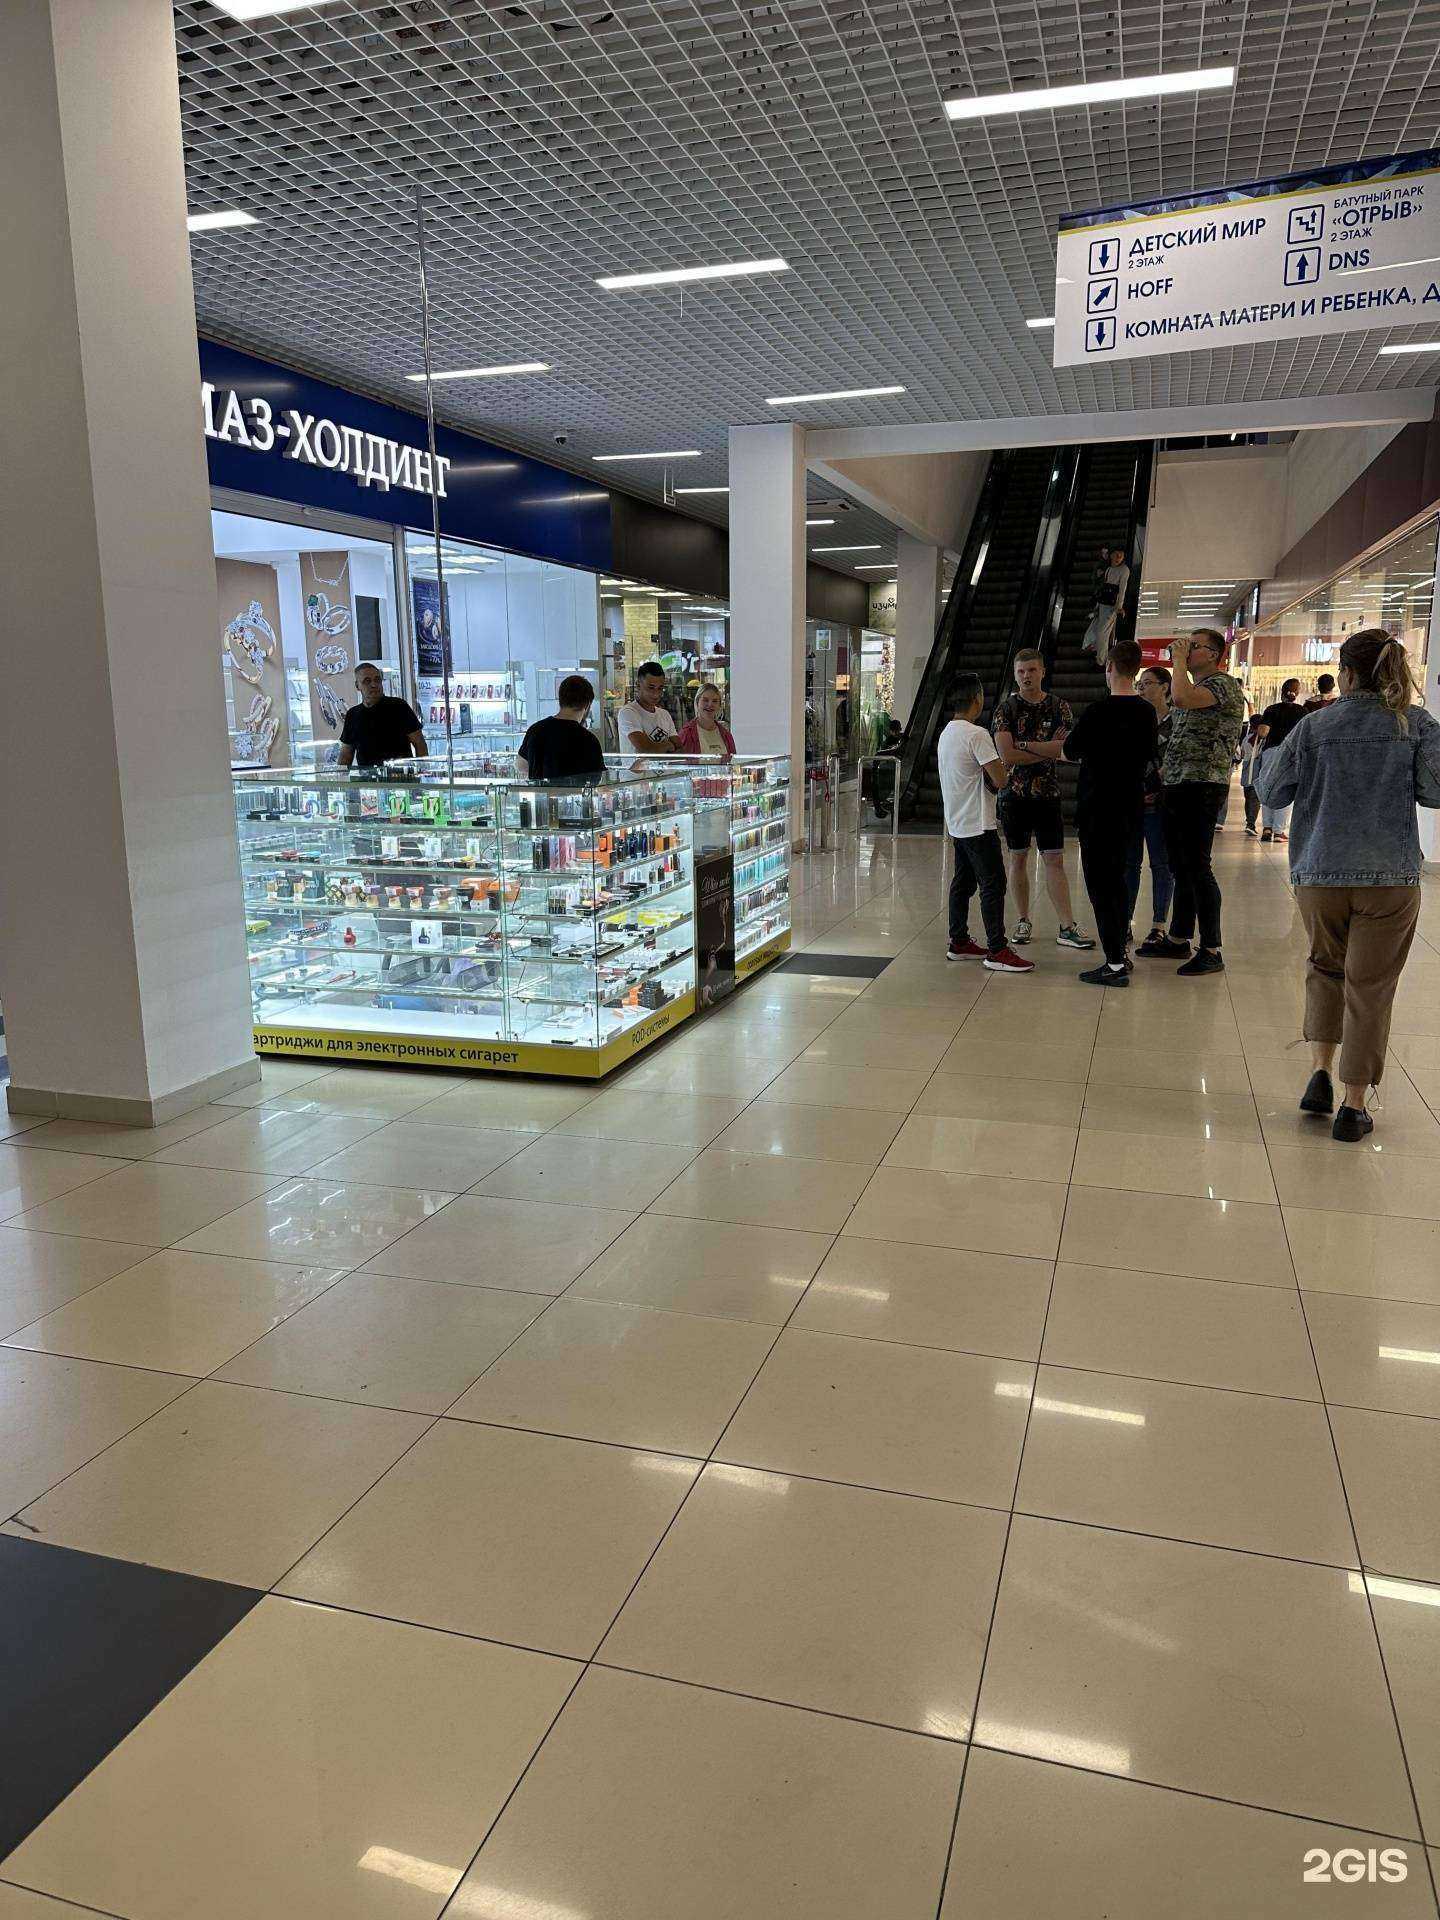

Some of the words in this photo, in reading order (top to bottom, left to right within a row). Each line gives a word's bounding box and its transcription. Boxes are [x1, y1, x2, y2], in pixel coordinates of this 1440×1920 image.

[1333, 189, 1392, 209] БАТУТНЫЙ
[1394, 185, 1425, 201] ПАРК
[1332, 200, 1424, 228] «ОТРЫВ»
[1128, 222, 1217, 257] ДЕТСКИЙ
[1221, 217, 1267, 240] МИР
[1330, 233, 1337, 243] 2
[1338, 226, 1373, 242] ЭТАЖ
[1128, 259, 1135, 270] 2
[1135, 255, 1165, 269] ЭТАЖ
[1328, 249, 1371, 272] DNS
[1127, 278, 1174, 300] HOFF
[1125, 313, 1214, 339] КОМНАТА
[1219, 301, 1296, 327] МАТЕРИ
[1300, 299, 1316, 316] И
[1321, 286, 1417, 314] РЕБЕНКА,
[327, 1039, 353, 1052] для
[357, 1041, 456, 1058] электронных
[460, 1049, 519, 1065] сигарет
